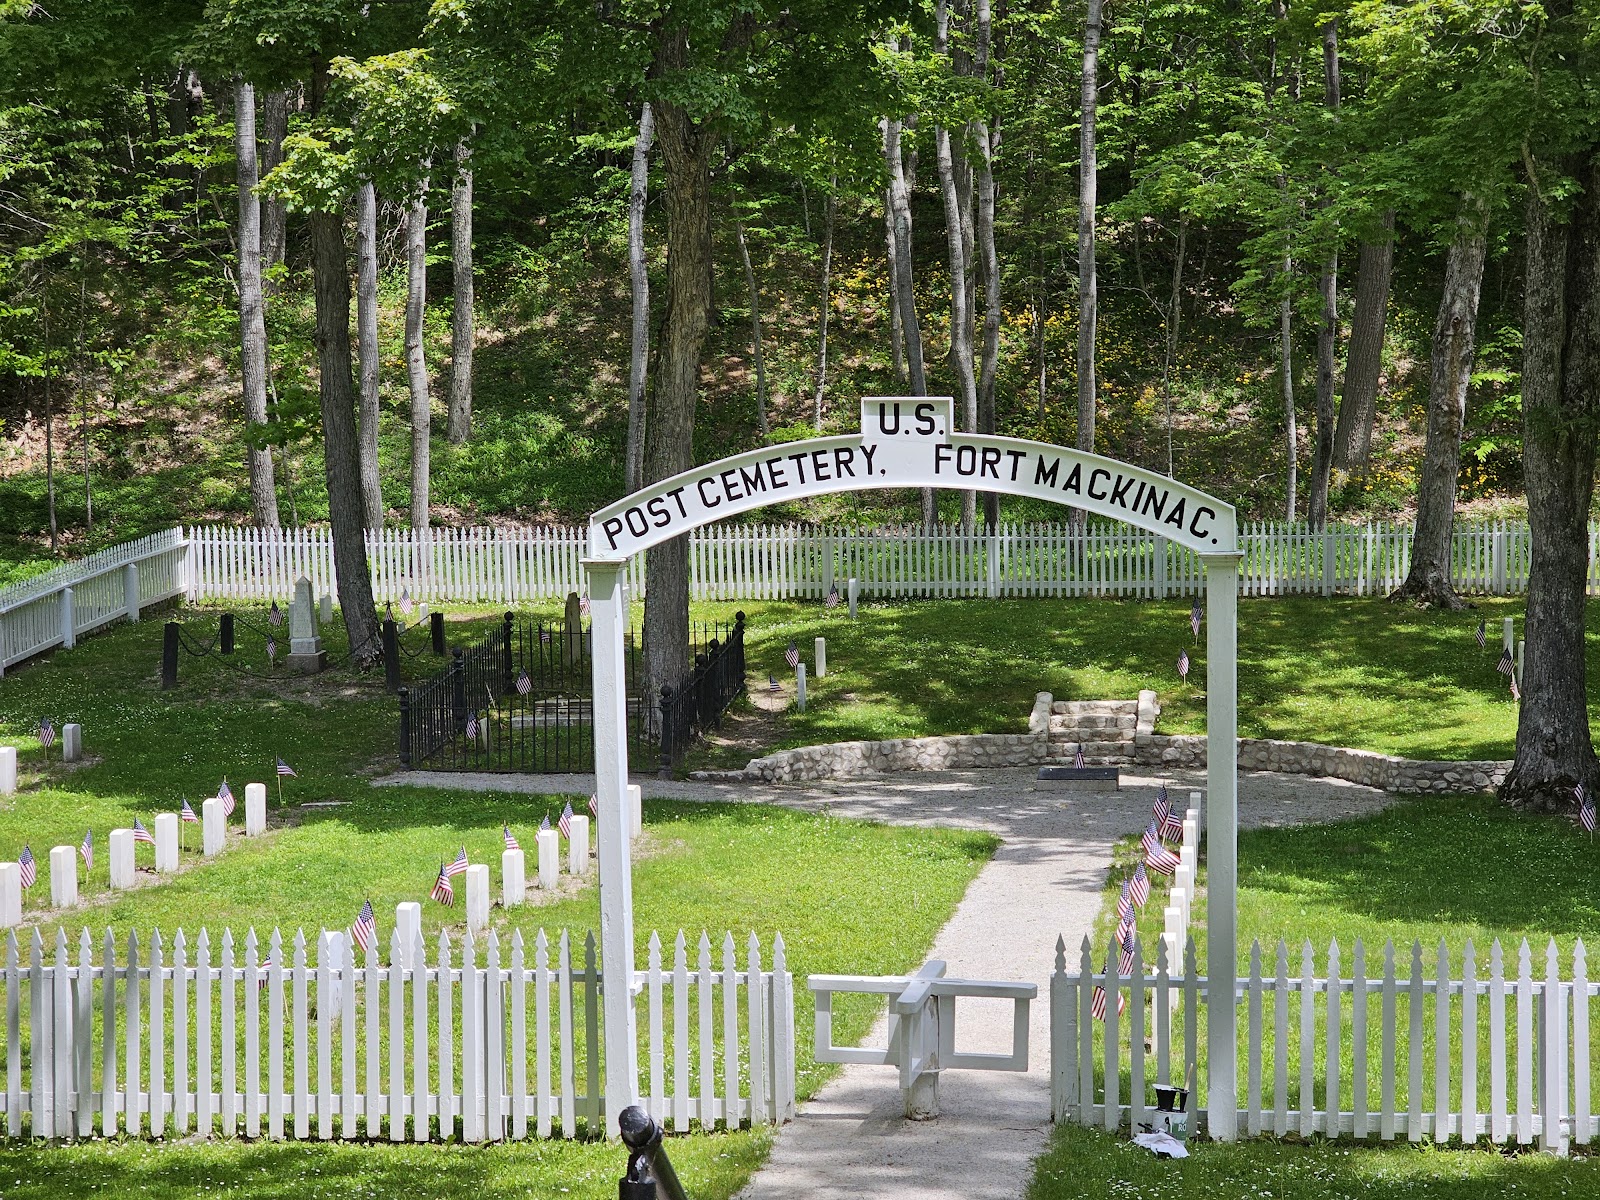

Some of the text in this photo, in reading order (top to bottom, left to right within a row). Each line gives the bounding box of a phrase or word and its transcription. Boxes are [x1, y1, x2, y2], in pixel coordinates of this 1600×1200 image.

[879, 403, 945, 436] U.S.
[602, 443, 1219, 551] POST CEMETERY, FORT MACKINAC.
